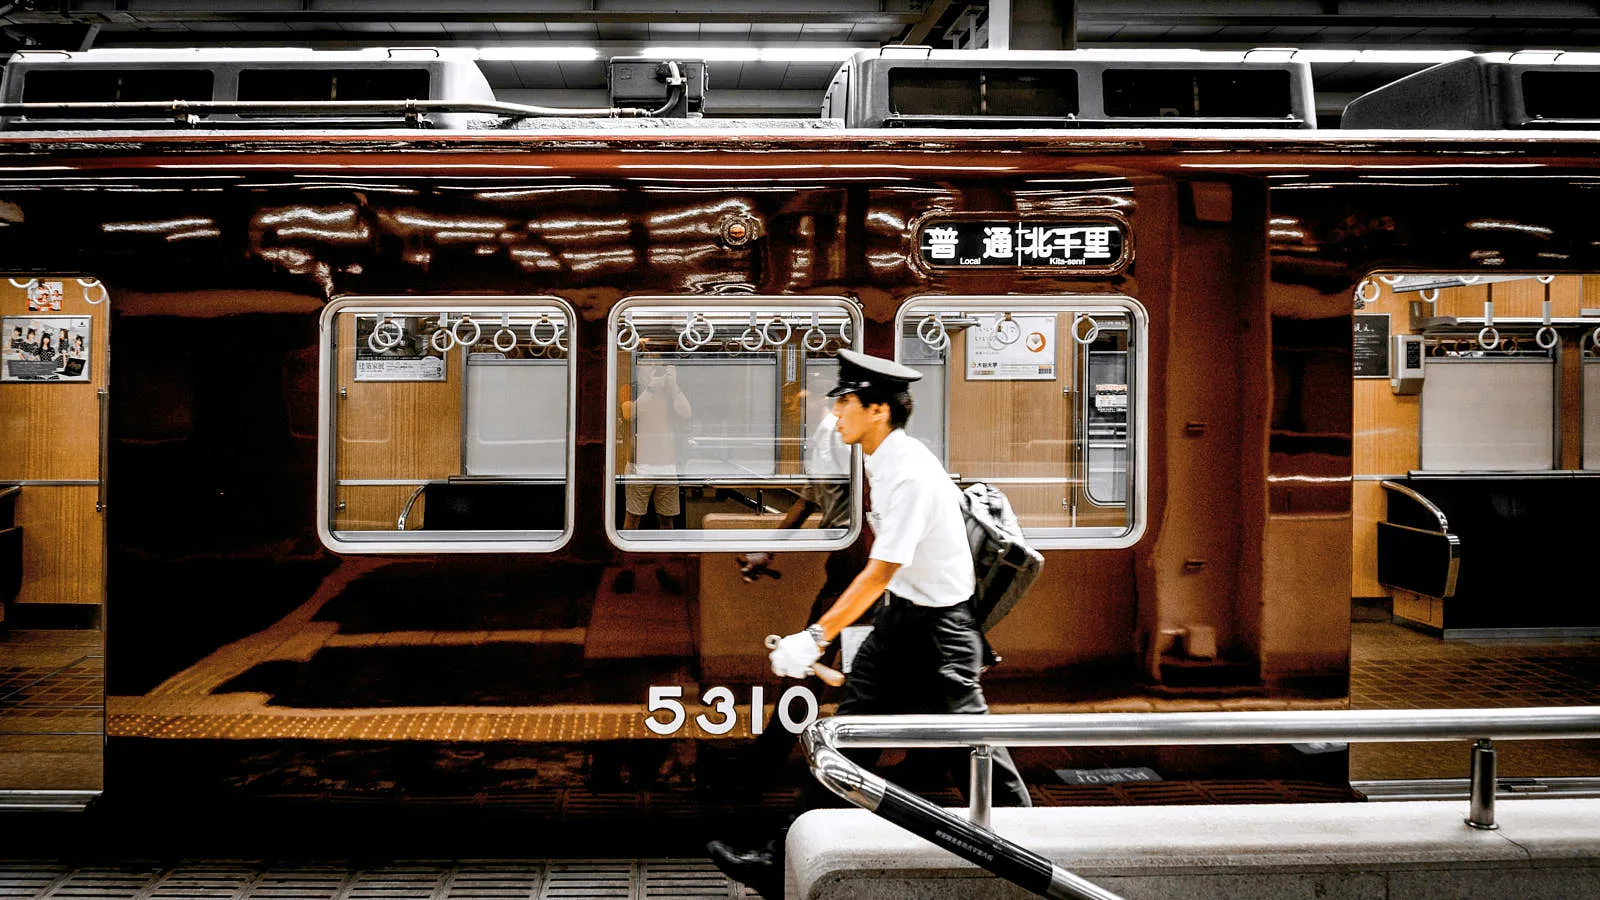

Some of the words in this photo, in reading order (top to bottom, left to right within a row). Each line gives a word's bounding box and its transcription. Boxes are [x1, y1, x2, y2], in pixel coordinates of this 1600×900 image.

[929, 227, 1013, 259] 普通
[1024, 227, 1111, 259] 北千里
[960, 257, 981, 265] Local
[1049, 257, 1085, 265] Kita-senri
[644, 685, 819, 735] 5310
